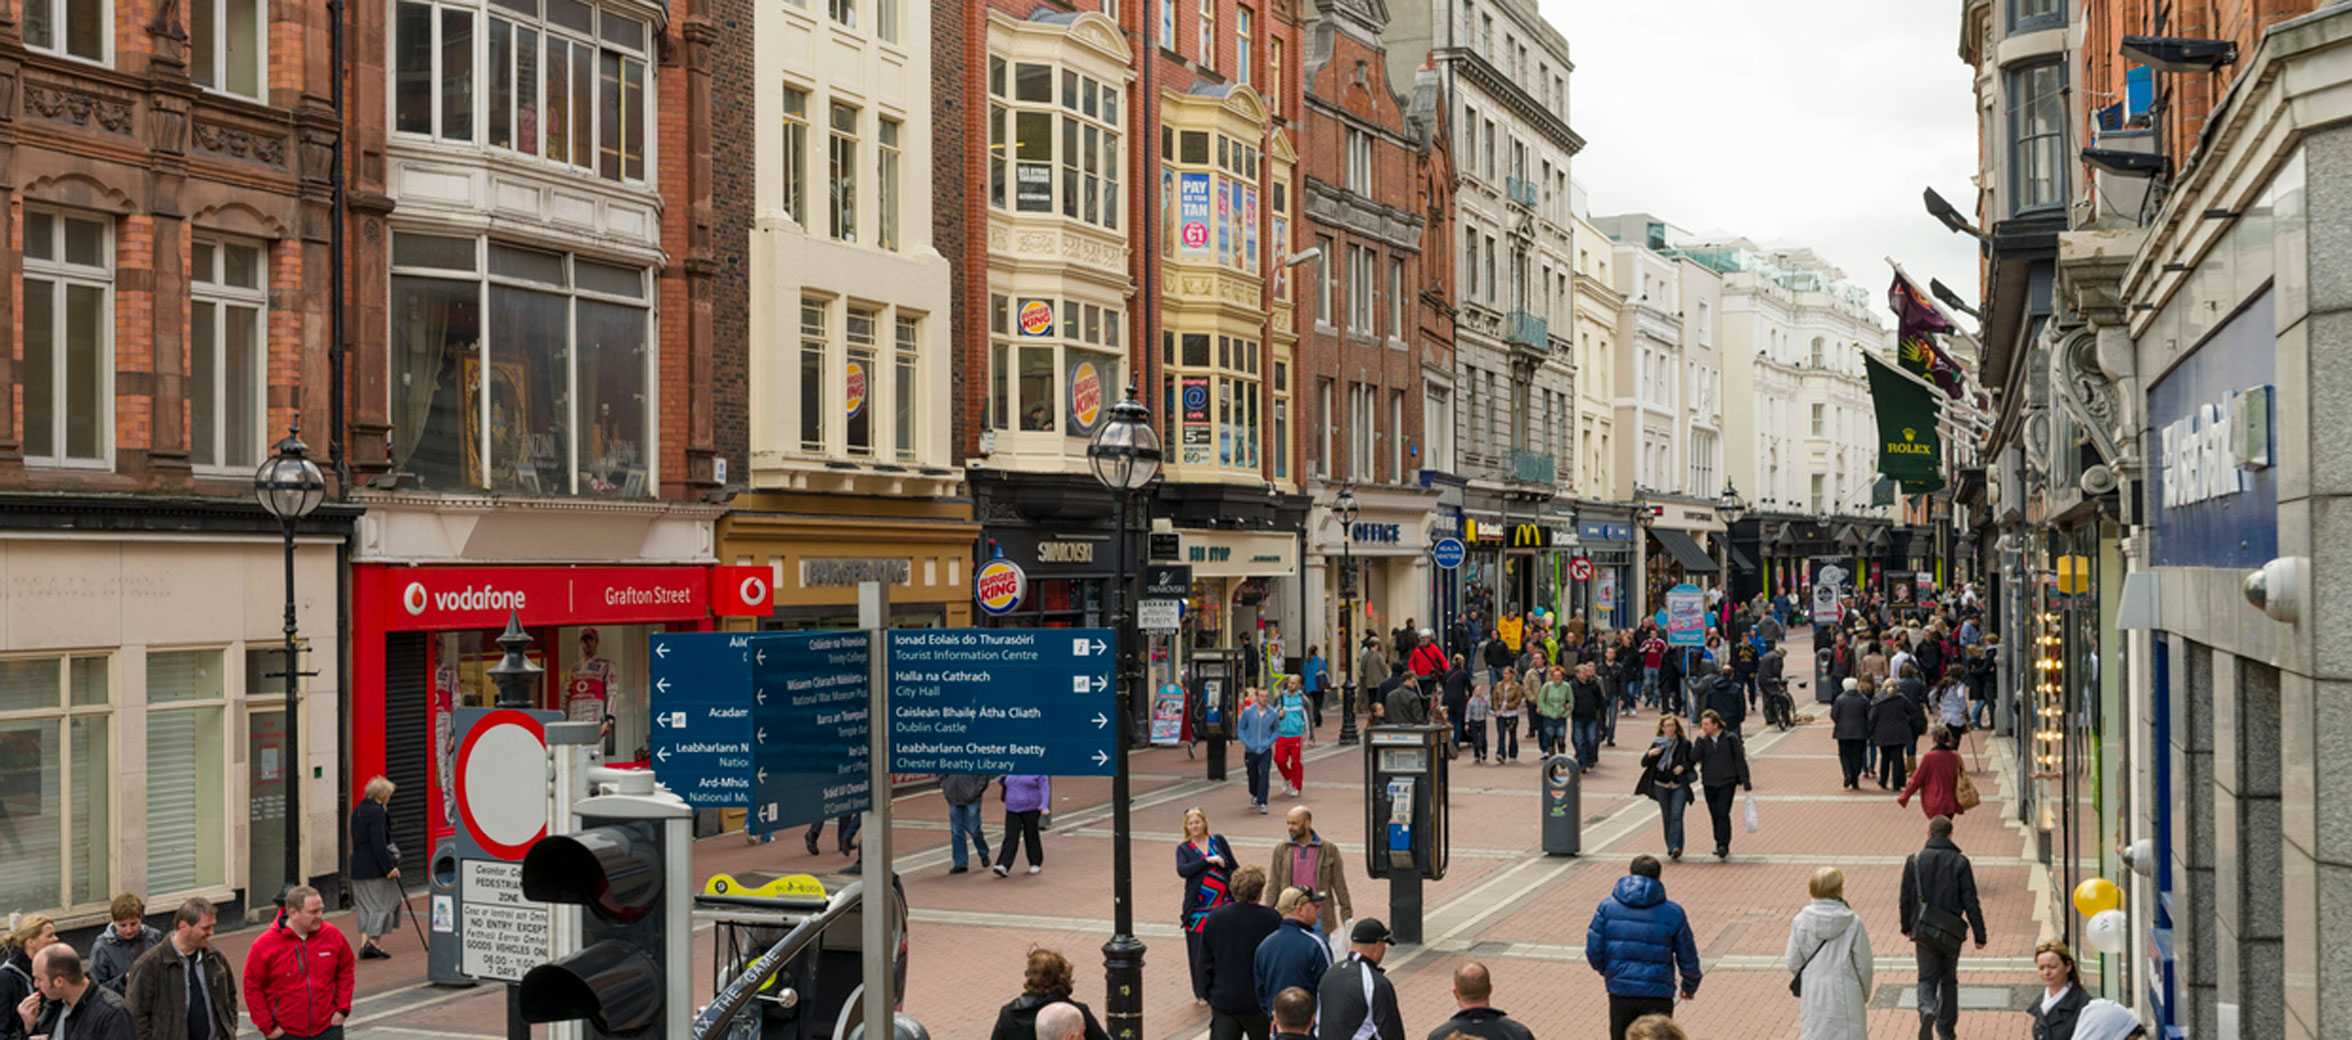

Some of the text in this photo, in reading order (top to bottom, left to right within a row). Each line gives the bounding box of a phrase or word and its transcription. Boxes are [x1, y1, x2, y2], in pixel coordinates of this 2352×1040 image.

[1182, 180, 1207, 194] PAY
[1183, 203, 1208, 217] TAN
[1021, 306, 1050, 321] BURGER
[1022, 312, 1051, 330] KING
[1075, 388, 1100, 416] KING
[1185, 432, 1197, 443] 5
[1888, 443, 1931, 455] ROLEX
[1352, 522, 1400, 542] OFFICE
[1037, 541, 1092, 563] SWAROVSKI
[1208, 546, 1230, 562] STOP
[979, 572, 1015, 589] BURGER
[980, 582, 1017, 602] KING
[1147, 585, 1185, 594] SWAROVSKI
[435, 585, 526, 611] vodafone
[605, 588, 691, 606] Grafton Street
[895, 634, 1035, 646] Ionad Eolais do Thurasóirí
[896, 650, 1039, 661] Tourist Information Centre
[896, 671, 990, 682] Halla na Cathrach
[896, 686, 940, 699] City Hall
[896, 705, 1041, 719] Caisleán Bhaile Átha Cliath
[896, 722, 967, 733] Dublin Castle
[676, 742, 739, 753] Leabharlann
[896, 743, 1045, 757] Leabharlann Chester Beatty
[719, 757, 748, 767] Natio
[897, 758, 1014, 771] Chester Beatty Library
[699, 777, 749, 787] Ard-Mhús
[689, 791, 731, 802] National
[475, 877, 521, 890] PEDESTRIA
[716, 882, 726, 892] 9
[498, 892, 518, 902] ZONE
[471, 918, 548, 934] NO ENTRY EXCEPT
[466, 940, 492, 952] GOODS
[496, 945, 530, 956] VEHICLES
[488, 966, 517, 978] 7 DAYS
[713, 988, 741, 1012] THE
[743, 952, 780, 983] GAME
